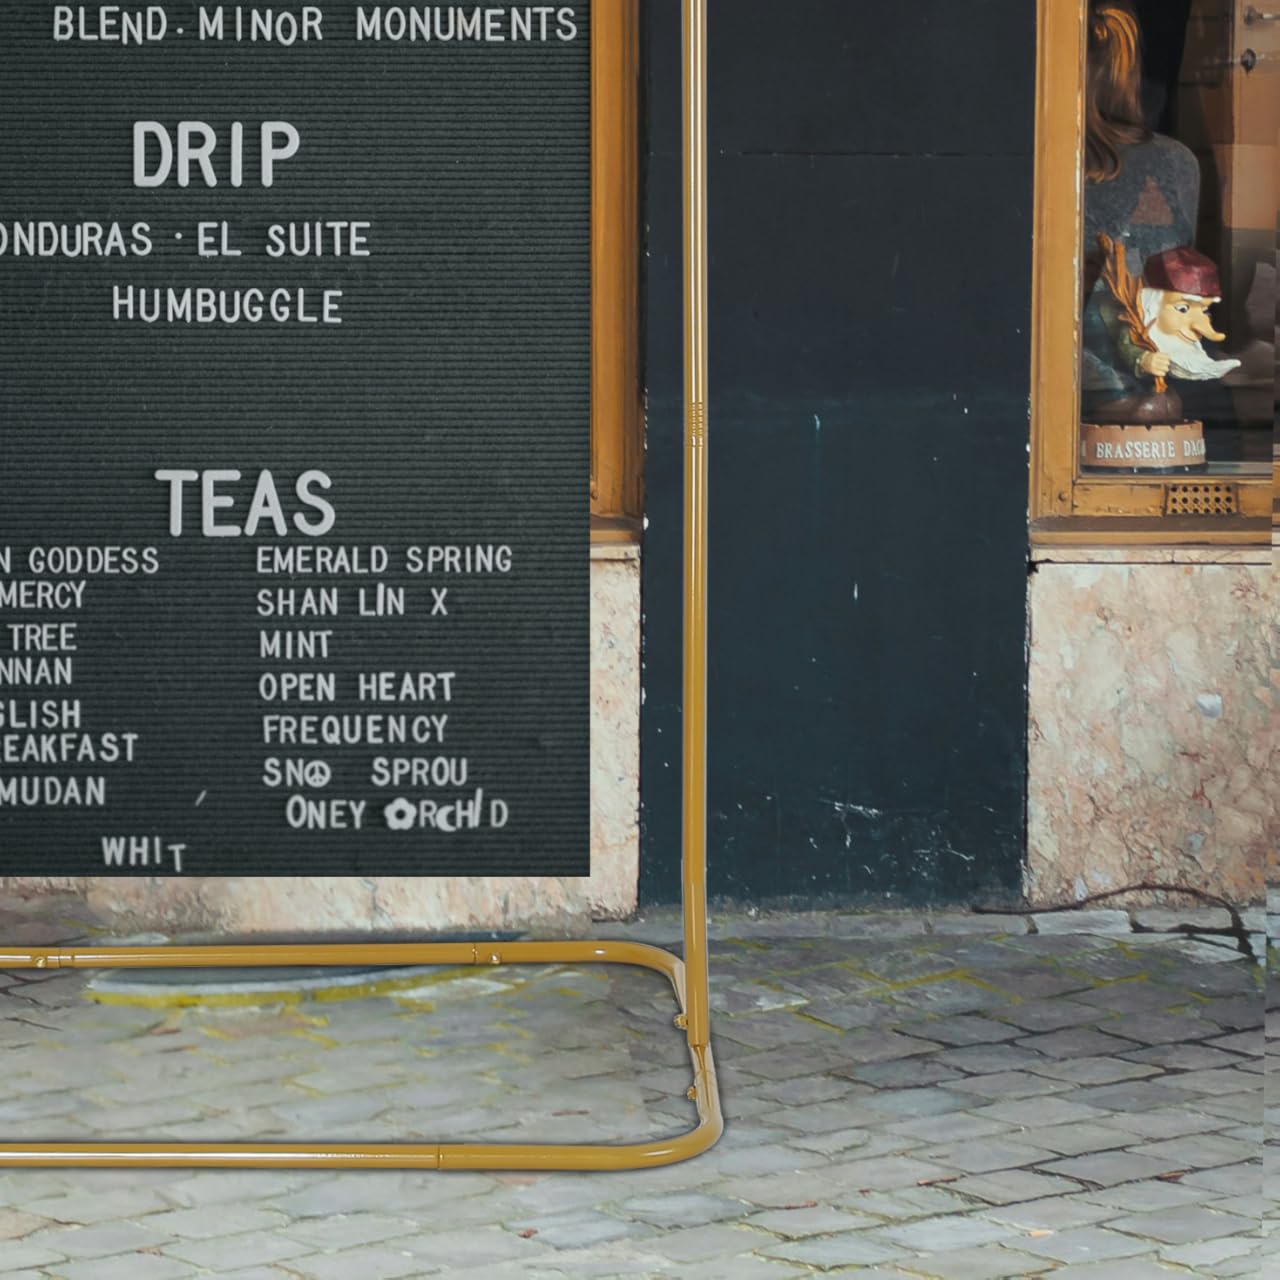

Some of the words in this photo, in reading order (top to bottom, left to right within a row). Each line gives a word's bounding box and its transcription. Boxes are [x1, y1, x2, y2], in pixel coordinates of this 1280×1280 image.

[199, 5, 323, 47] MINOR
[356, 6, 578, 43] MONUMENTS
[132, 120, 301, 188] DRIP
[197, 220, 242, 258] EL
[265, 221, 371, 258] SUITE
[112, 284, 343, 325] HUMBUGGLE
[1096, 440, 1176, 459] BRASSERIE
[154, 468, 336, 538] TEAS
[27, 546, 160, 575] GODDESS
[256, 545, 389, 575] EMERALD
[405, 544, 514, 574] SPRING
[256, 587, 339, 617] SHAN
[358, 581, 406, 617] LIN
[430, 586, 449, 617] X
[7, 622, 78, 652] TREE
[260, 628, 334, 660] MINT
[258, 672, 337, 703] OPEN
[358, 671, 457, 702] HEART
[262, 714, 450, 746] FREQUENCY
[371, 756, 469, 787] SPROU
[286, 793, 367, 830] ONEY
[101, 835, 187, 873] WHIT
